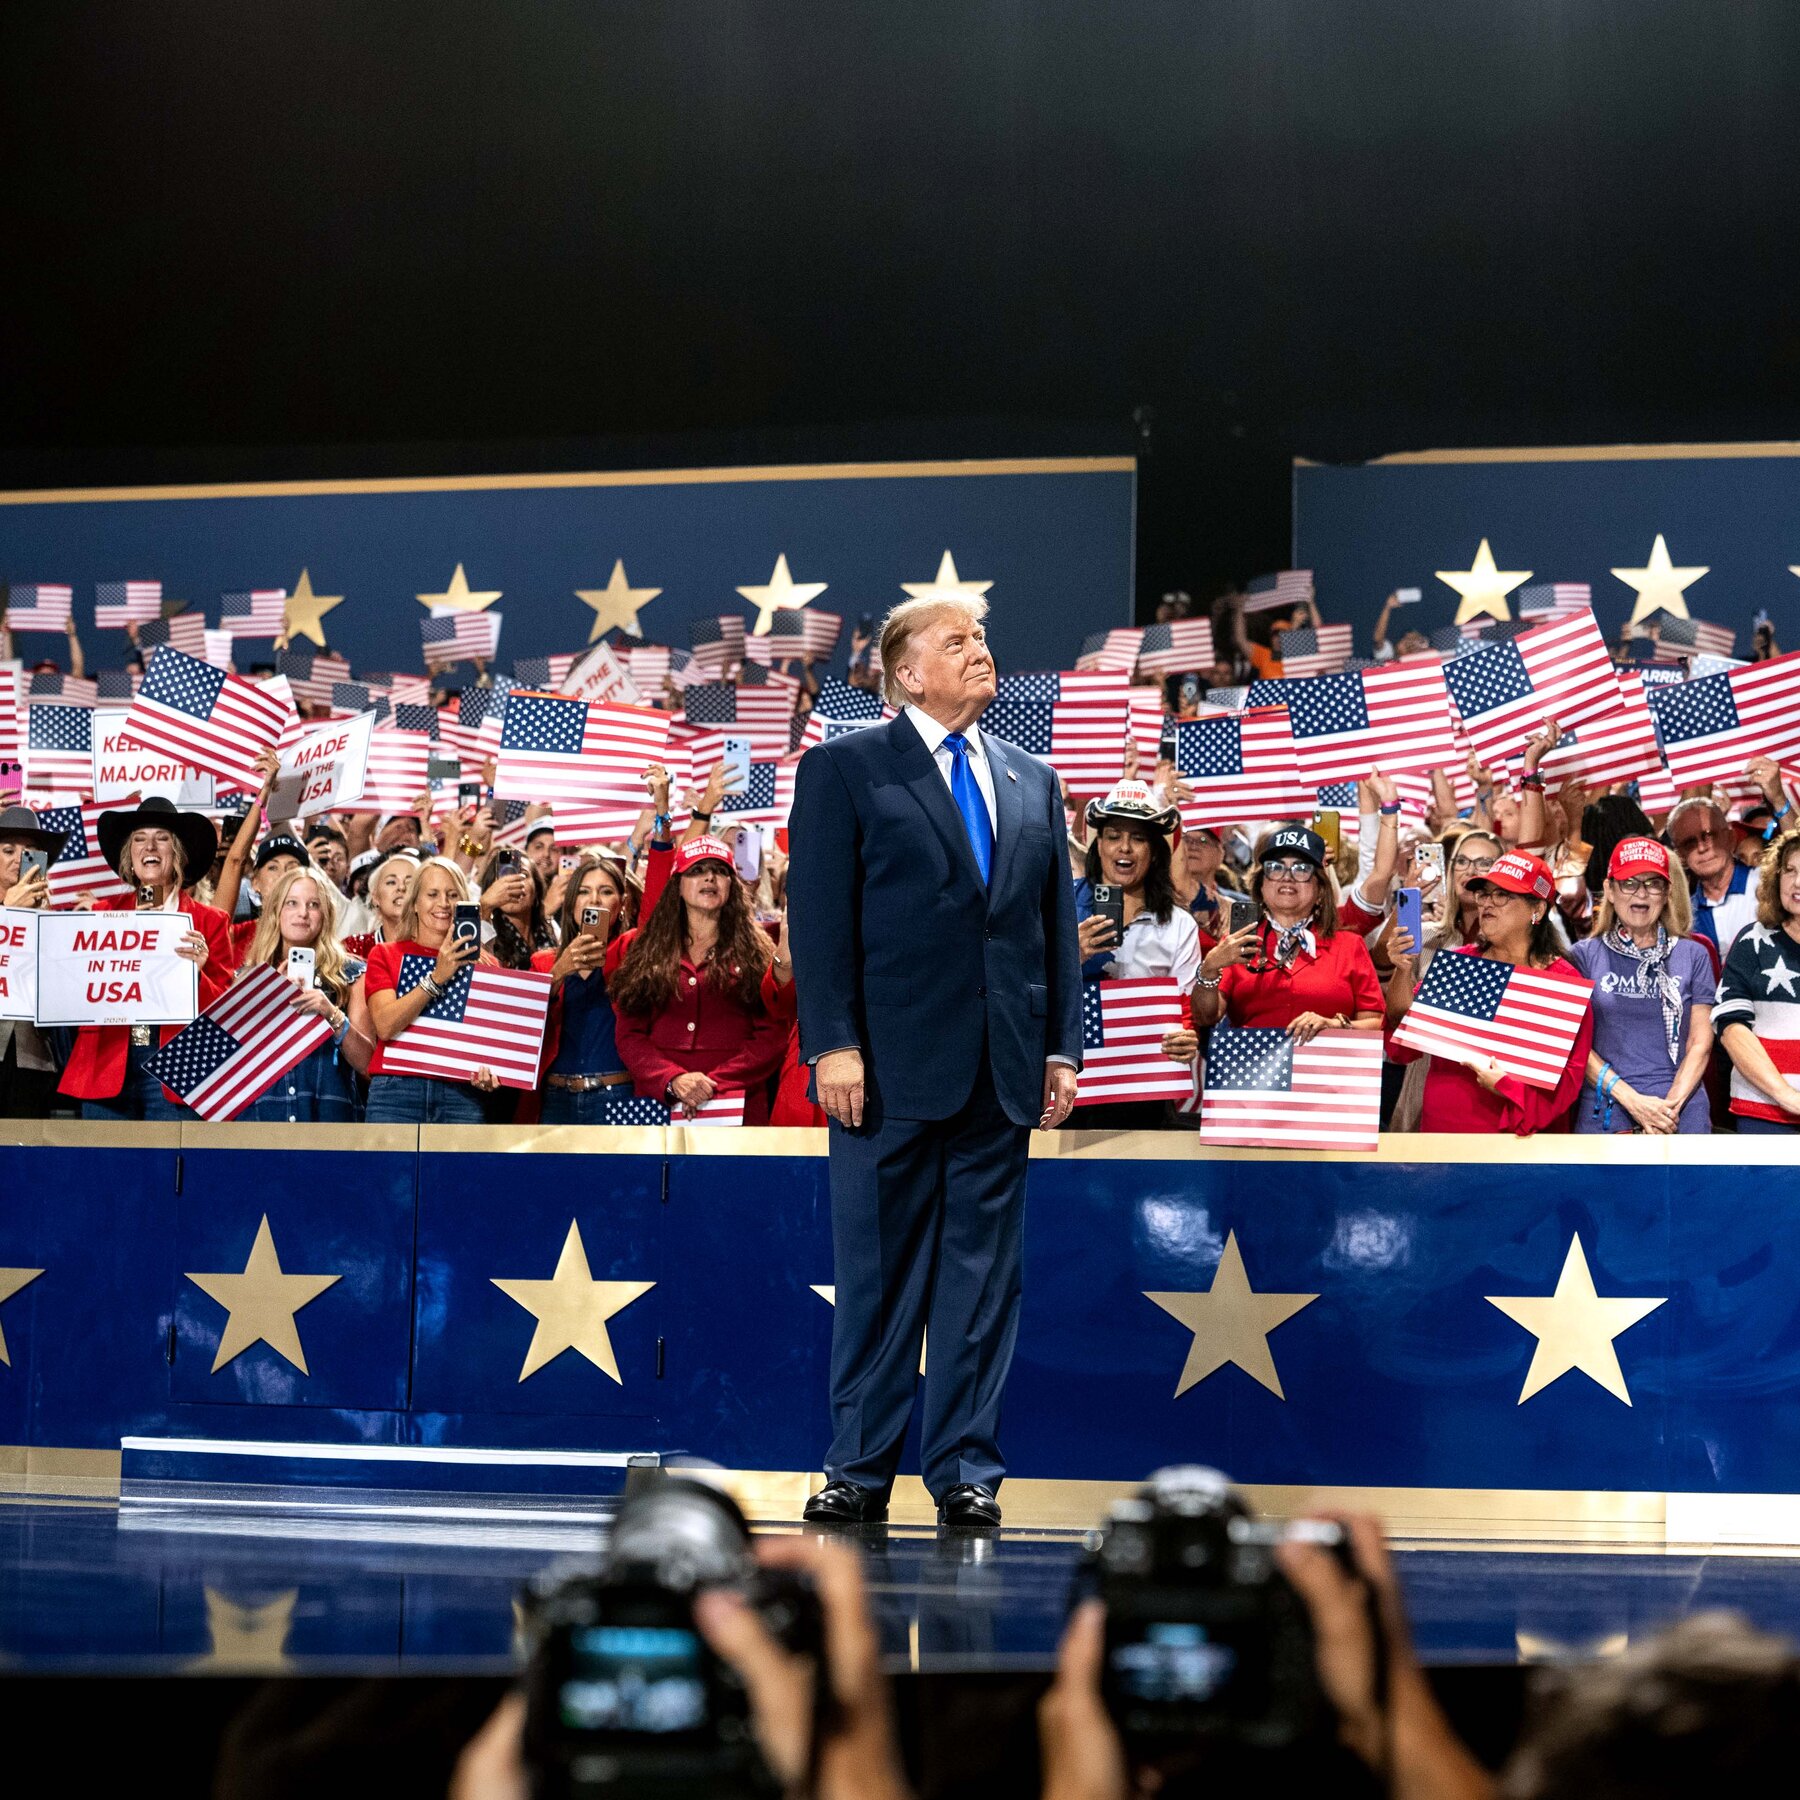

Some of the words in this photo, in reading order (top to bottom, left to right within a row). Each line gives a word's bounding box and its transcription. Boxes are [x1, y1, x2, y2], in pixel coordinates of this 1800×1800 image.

[1630, 668, 1684, 684] ARRIS
[103, 736, 143, 753] KEE
[294, 733, 350, 768] MADE
[100, 764, 203, 783] MAJORITY
[302, 769, 313, 781] IN
[315, 760, 335, 776] THE
[298, 778, 333, 804] USA
[1116, 790, 1147, 799] TRUMP
[682, 839, 701, 852] MAKE
[1275, 831, 1310, 850] USA
[1622, 840, 1649, 851] TRUMP
[685, 845, 708, 859] GREAT
[708, 845, 728, 858] AGAIN
[1620, 847, 1643, 858] RIGHT
[1500, 864, 1526, 881] AGAIN
[0, 925, 27, 947] DE
[73, 930, 160, 952] MADE
[87, 960, 105, 972] IN
[110, 960, 142, 972] THE
[86, 982, 143, 1003] USA
